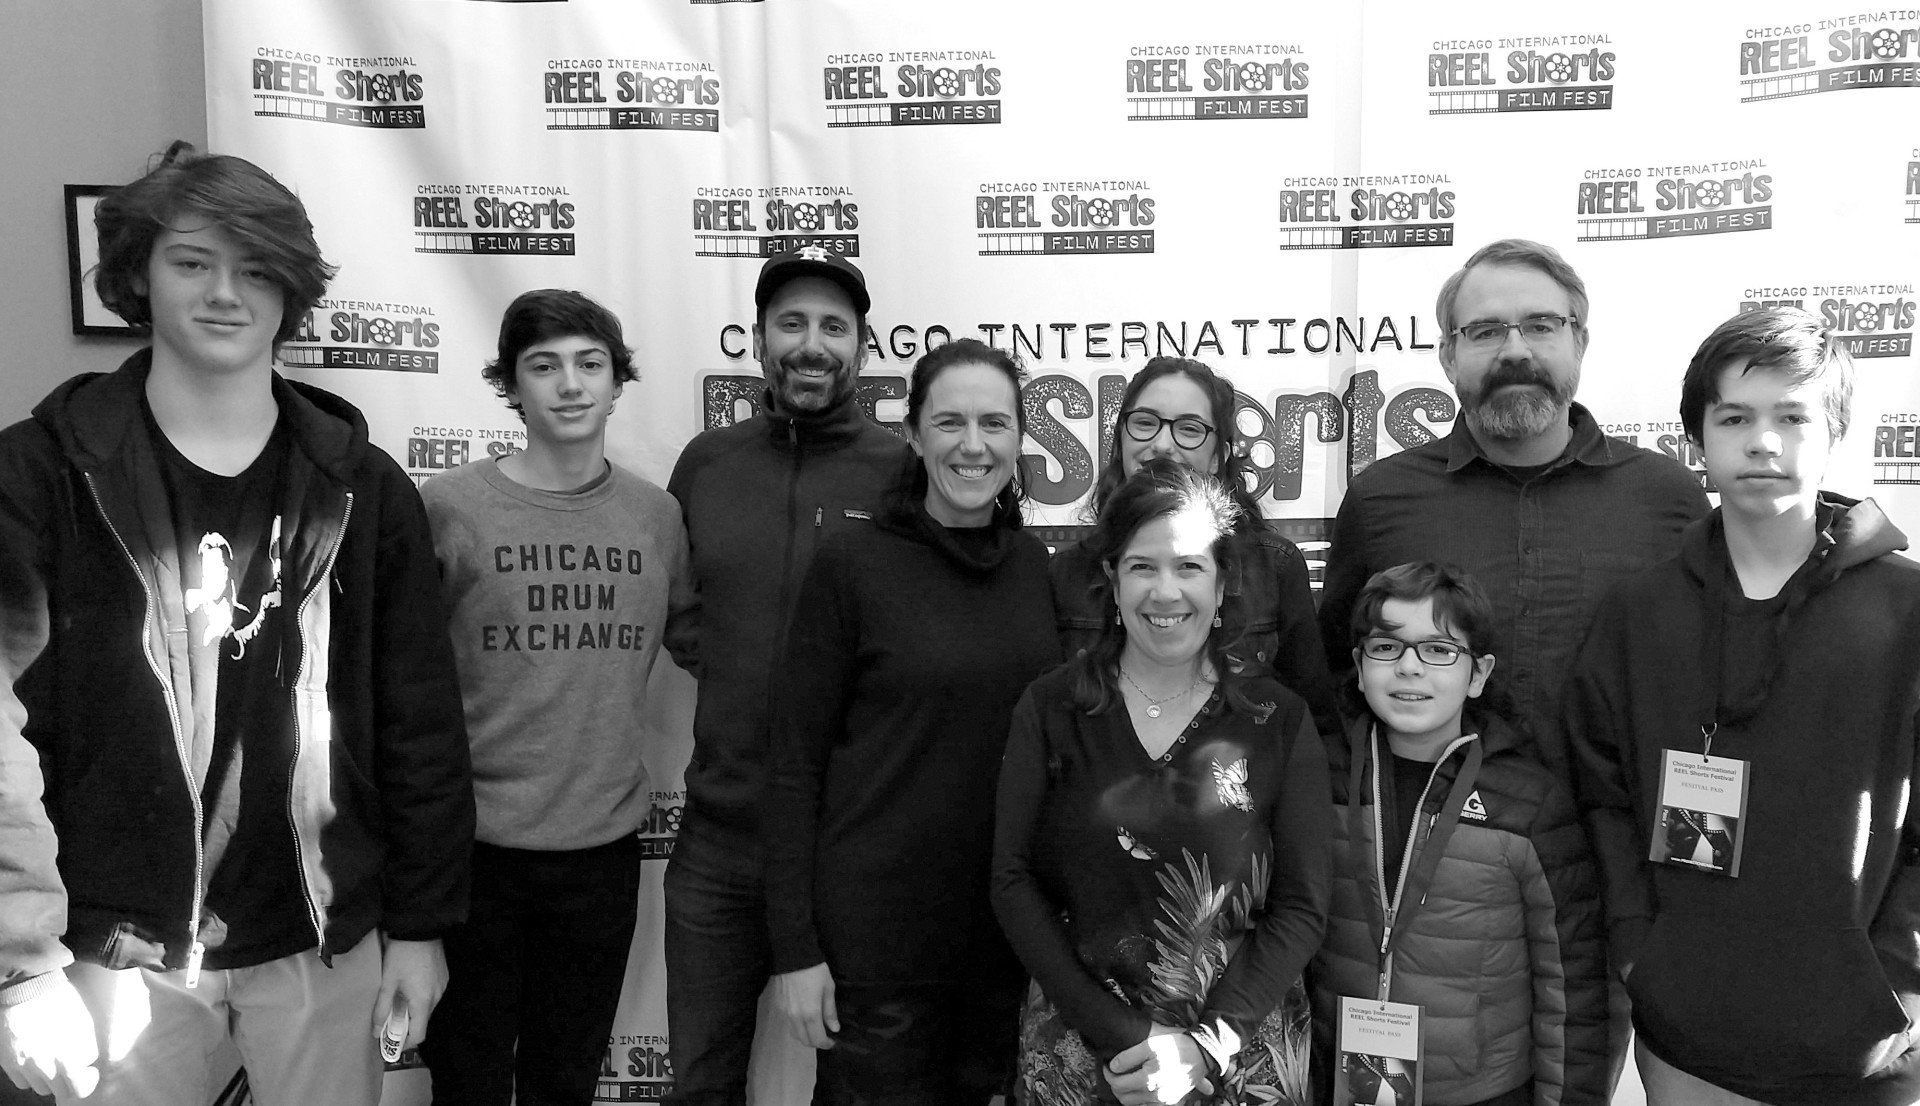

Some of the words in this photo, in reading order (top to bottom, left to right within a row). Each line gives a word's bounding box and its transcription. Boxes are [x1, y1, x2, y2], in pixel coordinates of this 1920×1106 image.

[1746, 24, 1811, 38] CHICAGO
[1433, 40, 1492, 50] CHICAGO
[1499, 34, 1612, 48] INTERNATIONAL
[258, 47, 320, 63] CHICAGO
[328, 56, 416, 69] INTERNATIONAL
[828, 53, 883, 64] CHICAGO
[889, 51, 996, 62] INTERNATIONAL
[1131, 46, 1189, 56] CHICAGO
[1196, 45, 1304, 55] INTERNATIONAL
[1740, 36, 1816, 75] REEL
[1829, 28, 1920, 62] Shor
[548, 60, 602, 69] CHICAGO
[608, 59, 715, 72] INTERNATIONAL
[1428, 53, 1496, 87] REEL
[1507, 48, 1616, 85] Shorts
[253, 56, 324, 96] REEL
[336, 69, 424, 102] Shorts
[824, 66, 888, 100] REEL
[898, 64, 1001, 100] Shorts
[1127, 59, 1193, 92] REEL
[1204, 58, 1309, 94] Shorts
[1829, 69, 1884, 85] FILM
[545, 72, 606, 103] REEL
[616, 71, 719, 106] Shorts
[1204, 101, 1251, 114] FILM
[1259, 100, 1305, 113] FEST
[1508, 92, 1555, 107] FILM
[1564, 91, 1610, 105] FEST
[336, 108, 385, 125] FILM
[390, 110, 421, 123] FEST
[618, 112, 663, 126] FILM
[671, 113, 716, 126] FEST
[900, 106, 945, 120] FILM
[953, 105, 998, 119] FEST
[1585, 169, 1641, 179] CHICAGO
[1647, 159, 1766, 177] INTERNATIONAL
[980, 183, 1037, 193] CHICAGO
[1043, 181, 1150, 192] INTERNATIONAL
[1284, 174, 1338, 188] CHICAGO
[1343, 174, 1450, 187] INTERNATIONAL
[418, 185, 461, 194] CHICAGO
[465, 185, 570, 196] INTERNATIONAL
[698, 187, 752, 198] CHICAGO
[1578, 181, 1644, 214] REEL
[1656, 172, 1772, 211] Shorts
[976, 196, 1041, 228] REEL
[1052, 194, 1155, 229] Shorts
[1280, 190, 1340, 222] REEL
[1351, 187, 1455, 222] Shorts
[414, 197, 468, 228] REEL
[475, 197, 575, 231] Shorts
[694, 199, 756, 231] REEL
[766, 199, 858, 233] Shorts
[1657, 217, 1707, 233] FILM
[1717, 211, 1768, 228] FEST
[478, 237, 520, 250] FILM
[528, 238, 572, 250] FEST
[1053, 236, 1098, 249] FILM
[1106, 235, 1151, 248] FEST
[1351, 230, 1396, 243] FILM
[1404, 228, 1450, 242] FEST
[1745, 288, 1807, 298] CHICAGO
[1813, 285, 1914, 296] INTERNATIONAL
[321, 300, 435, 316] INTERNATIONAL
[331, 312, 440, 348] Shorts
[978, 316, 1434, 360] INTERNATIONAL
[1868, 338, 1909, 352] FEST
[332, 352, 380, 365] FILM
[388, 354, 435, 368] FEST
[1881, 414, 1920, 423] CHIC
[413, 427, 472, 438] CHICAGO
[494, 545, 641, 575] CHICAGO
[528, 584, 615, 611] DRUM
[483, 623, 644, 651] EXCHANGE
[1672, 760, 1696, 769] Chicago
[1697, 764, 1736, 775] International
